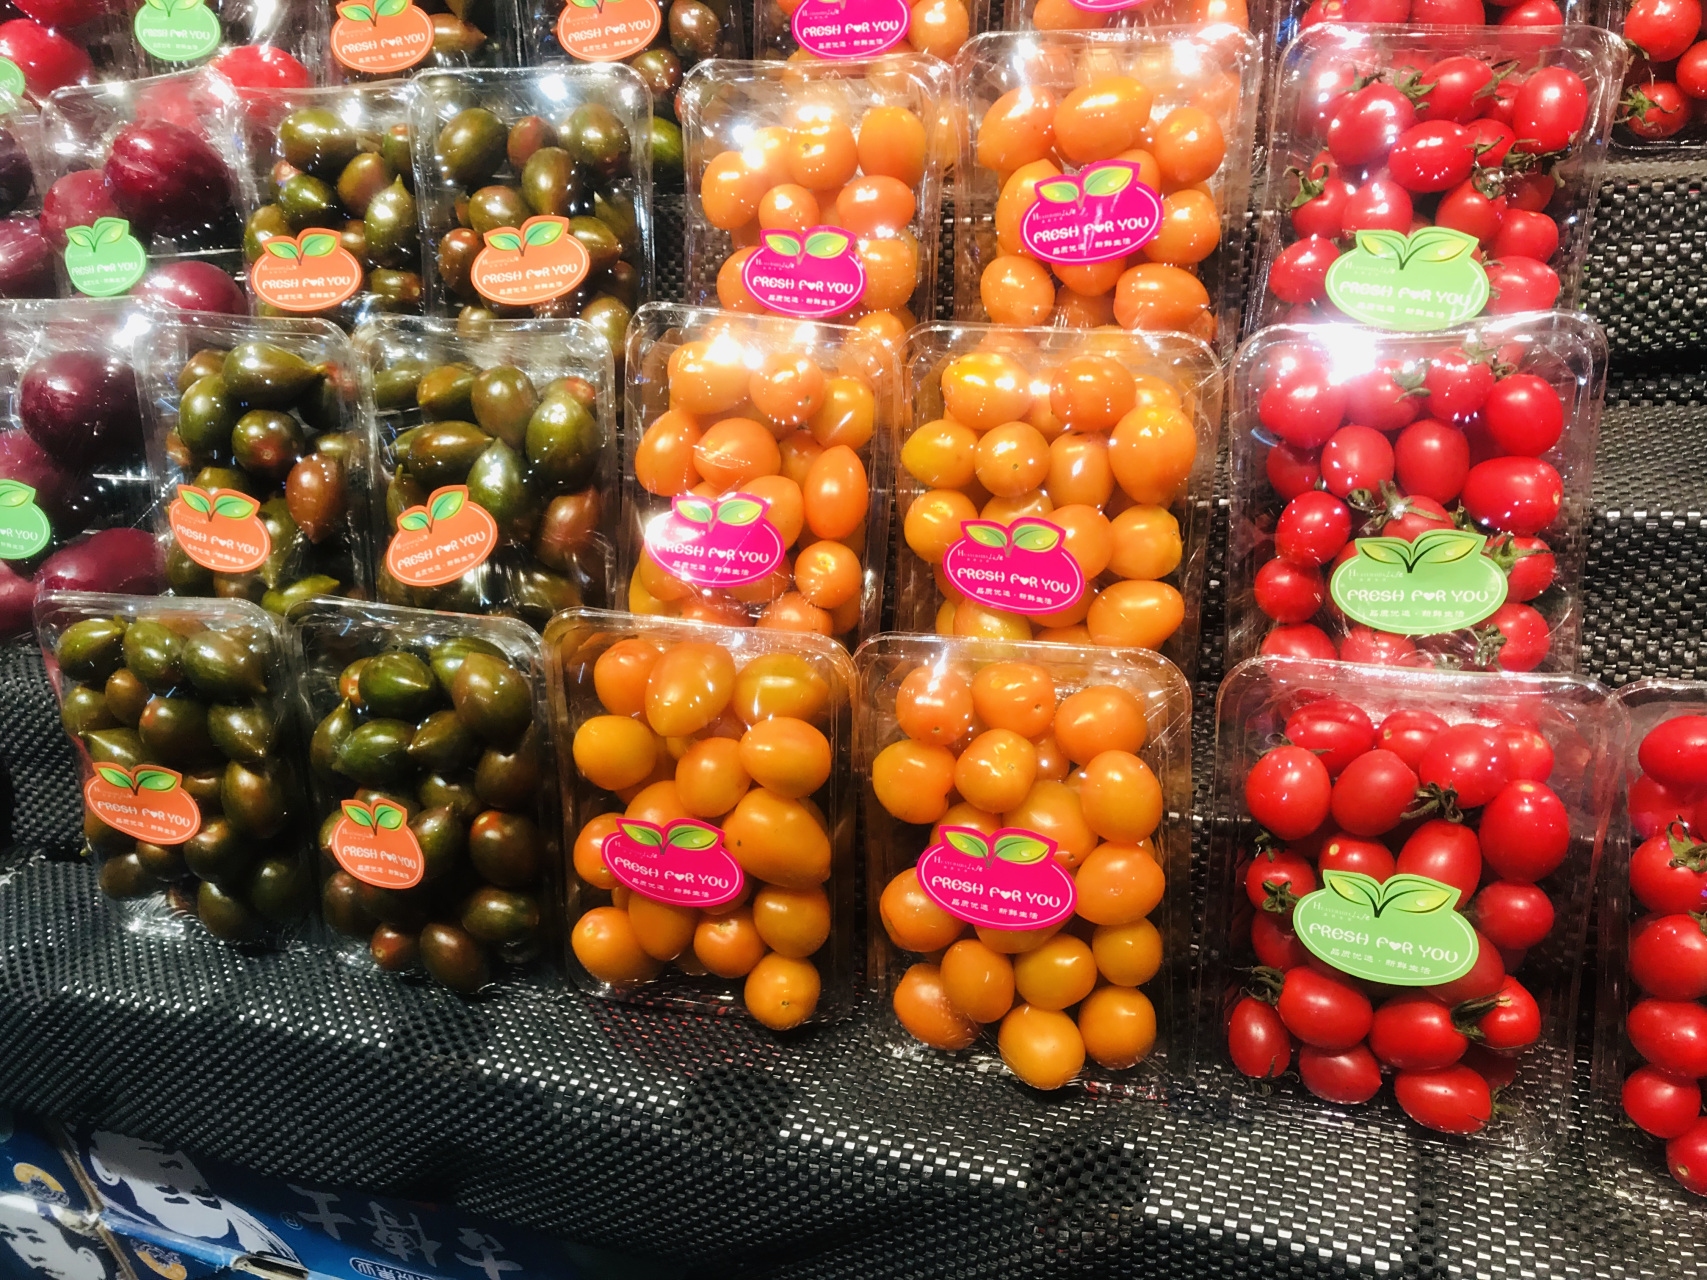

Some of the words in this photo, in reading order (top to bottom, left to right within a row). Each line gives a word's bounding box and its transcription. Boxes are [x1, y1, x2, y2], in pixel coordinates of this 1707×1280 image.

[568, 28, 602, 42] FRESH
[628, 19, 651, 31] YOU
[802, 25, 841, 37] FRESH
[872, 20, 899, 32] YOU
[341, 40, 378, 54] FRESH
[404, 32, 425, 45] YOU
[1033, 225, 1079, 244] FRESH
[1117, 216, 1150, 232] YOU
[262, 278, 299, 289] FRESH
[326, 276, 351, 286] YOU
[482, 271, 522, 285] FRESH
[552, 263, 578, 276] YOU
[753, 275, 795, 290] FRESH
[826, 282, 854, 295] YOU
[15, 529, 39, 541] YOU
[176, 523, 207, 543] FRESH
[236, 541, 260, 557] YOU
[397, 548, 434, 570] FRESH
[459, 530, 487, 548] YOU
[738, 550, 770, 564] YOU
[956, 567, 1006, 583] FRESH
[1041, 577, 1071, 594] YOU
[1346, 590, 1405, 603] FRESH
[1450, 590, 1489, 603] YOU
[97, 800, 138, 815] FRESH
[167, 812, 191, 828] YOU
[342, 845, 378, 860] FRESH
[397, 855, 417, 870] YOU
[614, 856, 659, 878] FRESH
[697, 873, 729, 889] YOU
[931, 875, 984, 896] FRESH
[1025, 892, 1061, 909] YOU
[1309, 922, 1369, 946] FRESH
[1418, 944, 1459, 964] YOU
